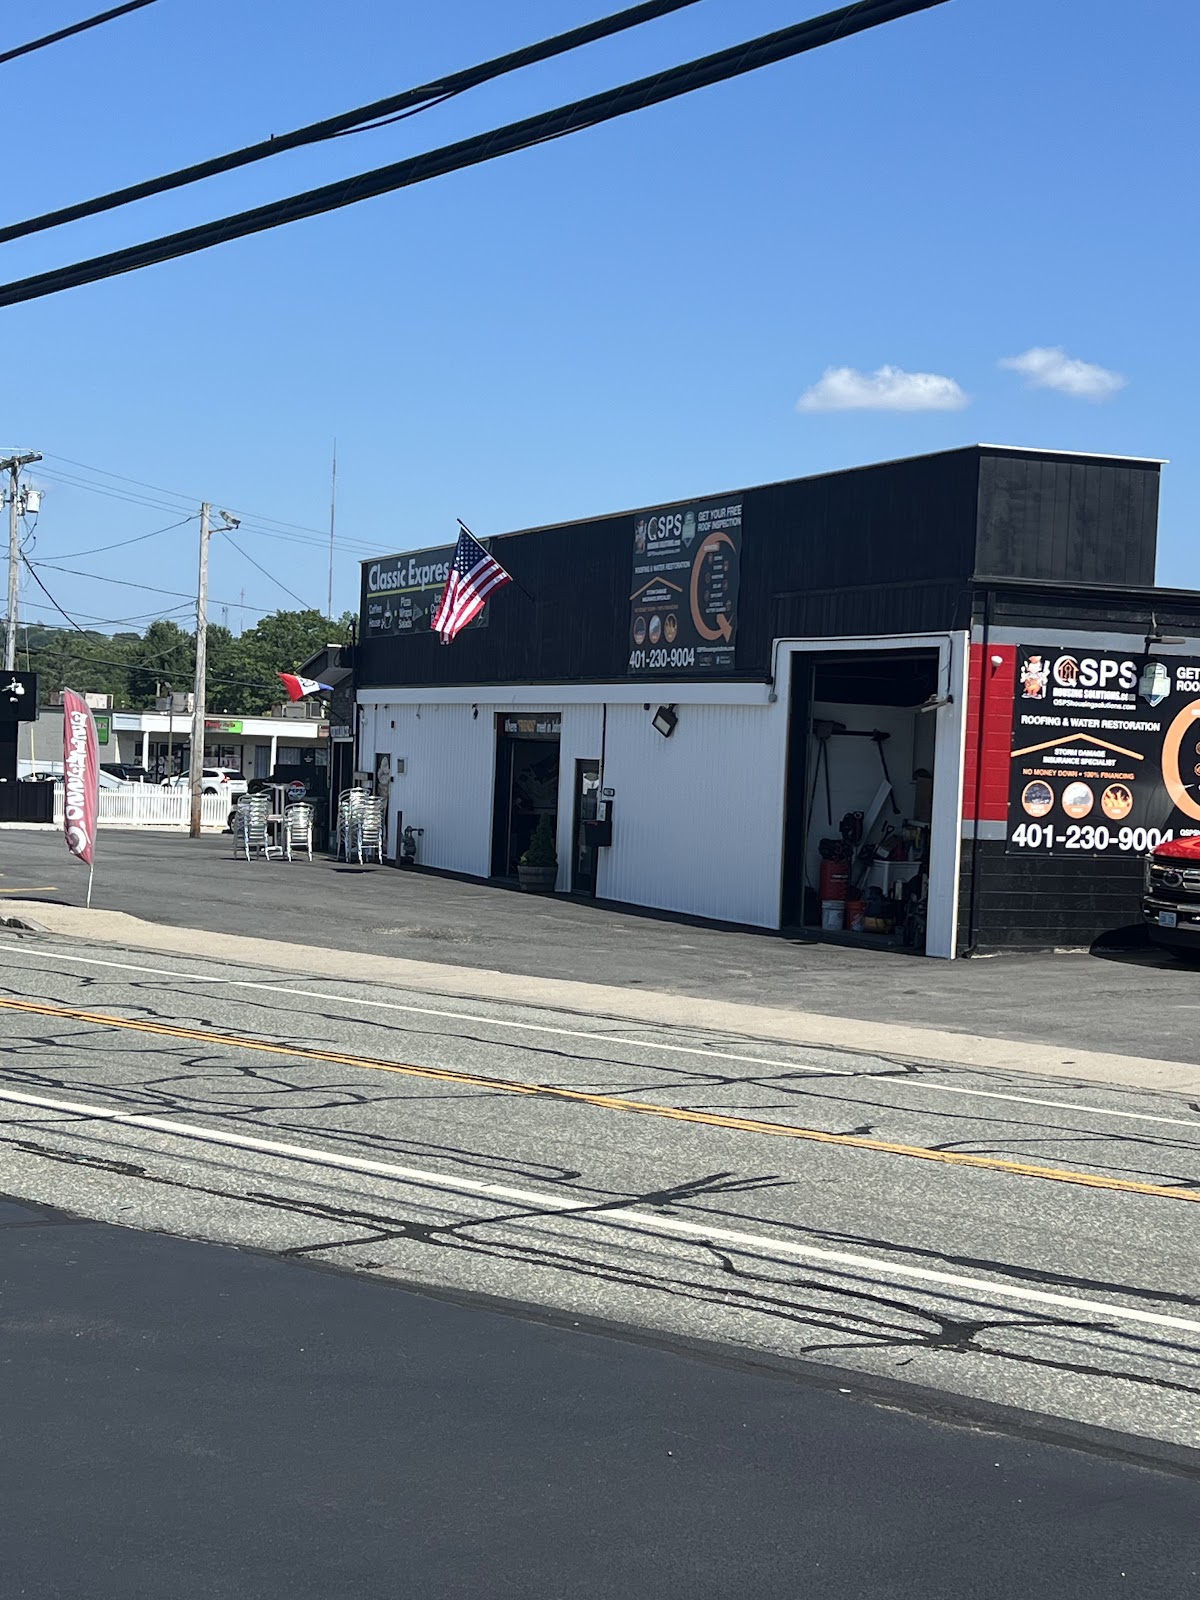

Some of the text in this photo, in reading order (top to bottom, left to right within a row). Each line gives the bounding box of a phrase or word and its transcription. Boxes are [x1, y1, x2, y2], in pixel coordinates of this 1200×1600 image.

[698, 505, 743, 522] GET YOUR FREE
[698, 517, 742, 532] ROOF INSPECTION
[369, 559, 449, 591] Classic Expres
[630, 648, 695, 669] 401-230-9004
[1176, 666, 1200, 680] GET
[1176, 680, 1200, 692] ROO
[1021, 716, 1161, 732] ROOFING & WATER RESTORATION
[1079, 750, 1107, 758] DAMAGE
[1043, 757, 1117, 767] INSURANCE SPECIALIST
[1034, 769, 1058, 777] MONEY
[1101, 773, 1135, 781] FINANCING
[1012, 824, 1174, 852] 401-230-9004
